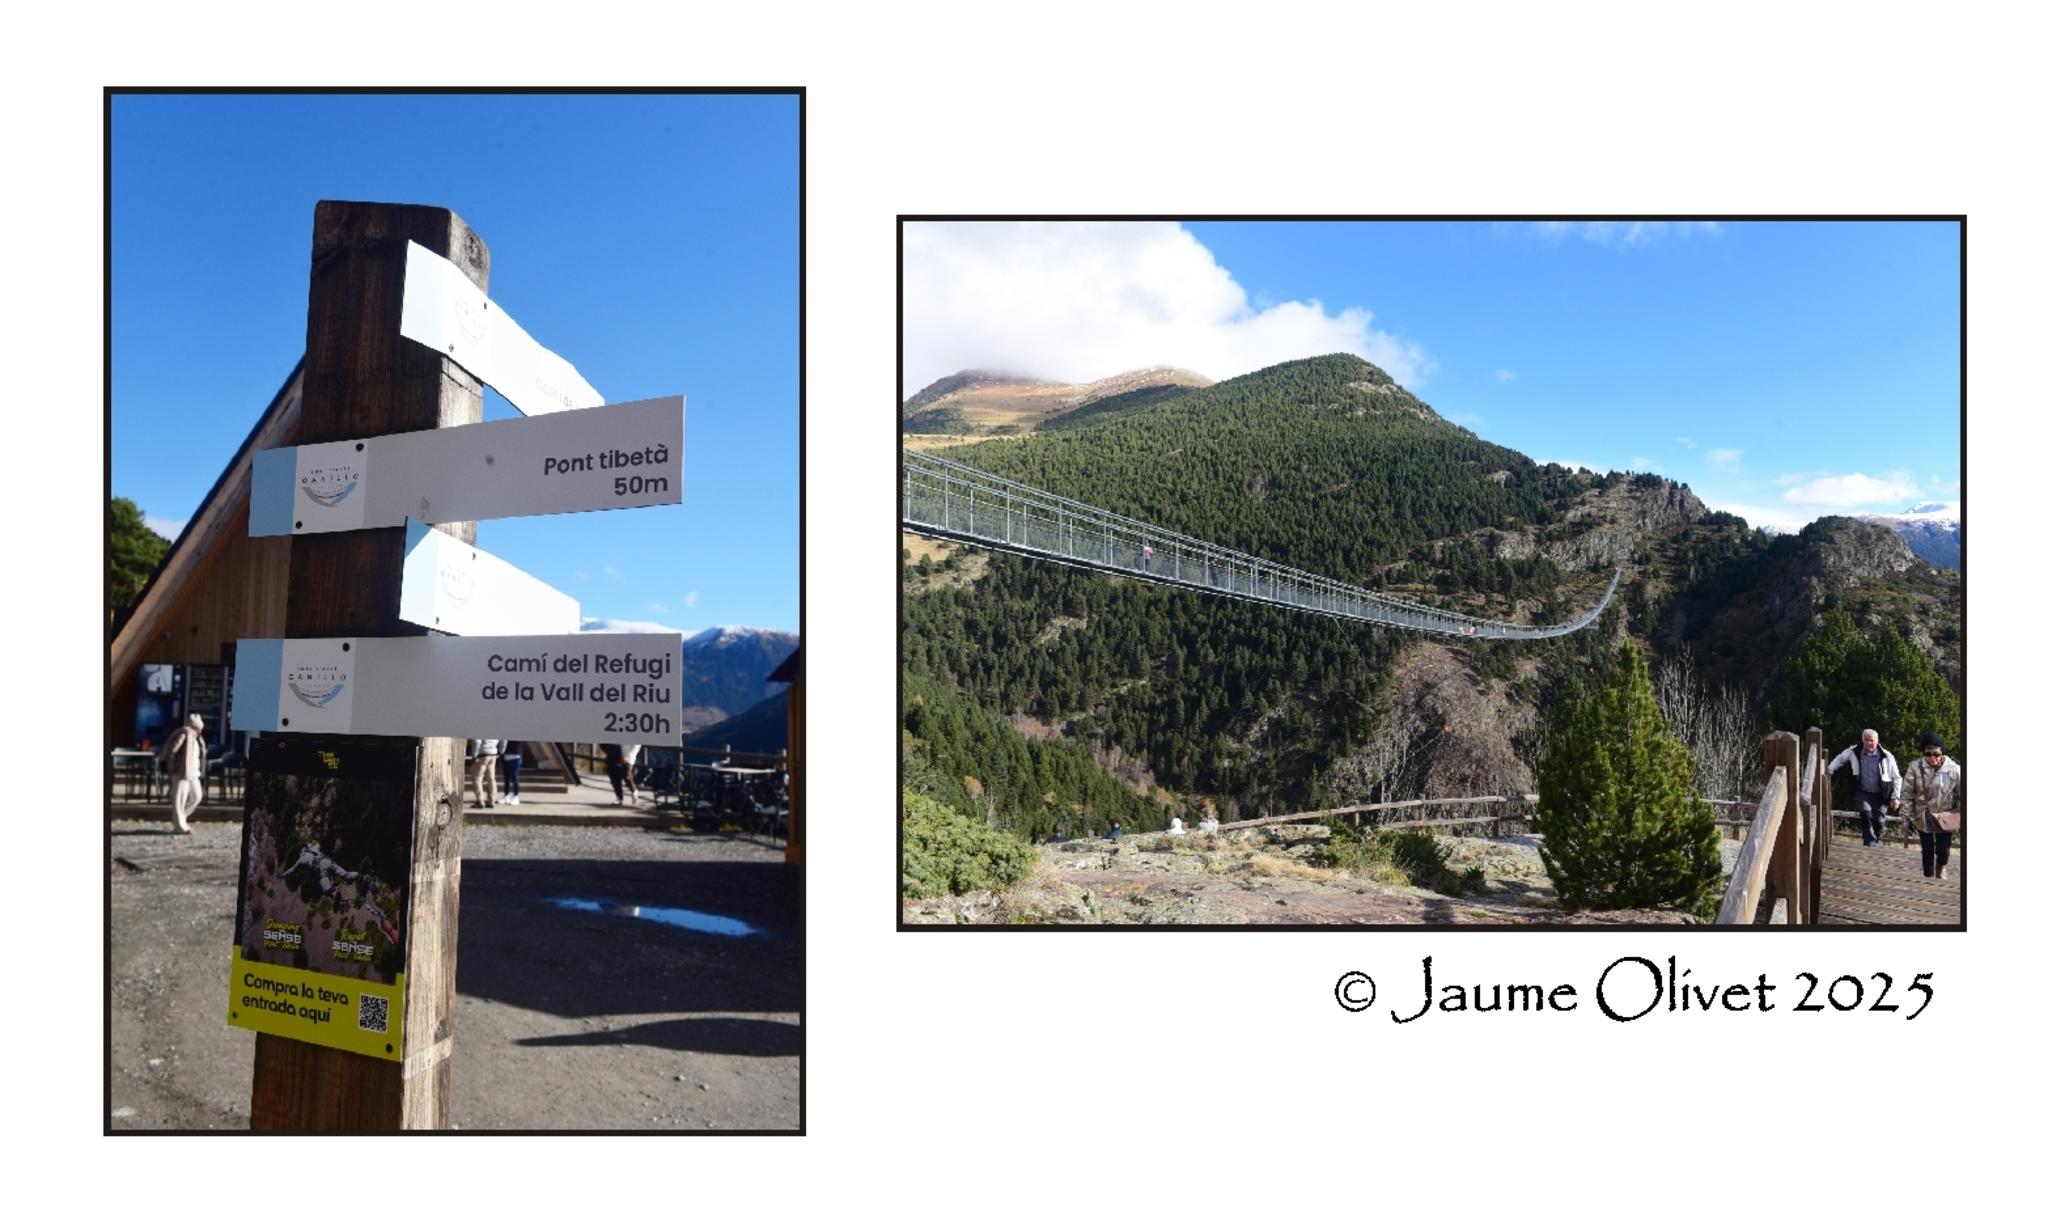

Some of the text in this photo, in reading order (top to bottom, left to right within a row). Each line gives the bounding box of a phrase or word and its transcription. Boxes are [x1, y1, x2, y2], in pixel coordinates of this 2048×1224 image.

[543, 443, 669, 476] Pont tibetà
[614, 475, 669, 496] 50m
[487, 653, 671, 680] Camí del Refugi
[481, 682, 671, 703] de la Vall del Riu
[604, 712, 671, 734] 2:30h
[332, 941, 374, 956] SENSE
[244, 973, 349, 1005] Compra la teva
[242, 995, 332, 1024] entrada aquí
